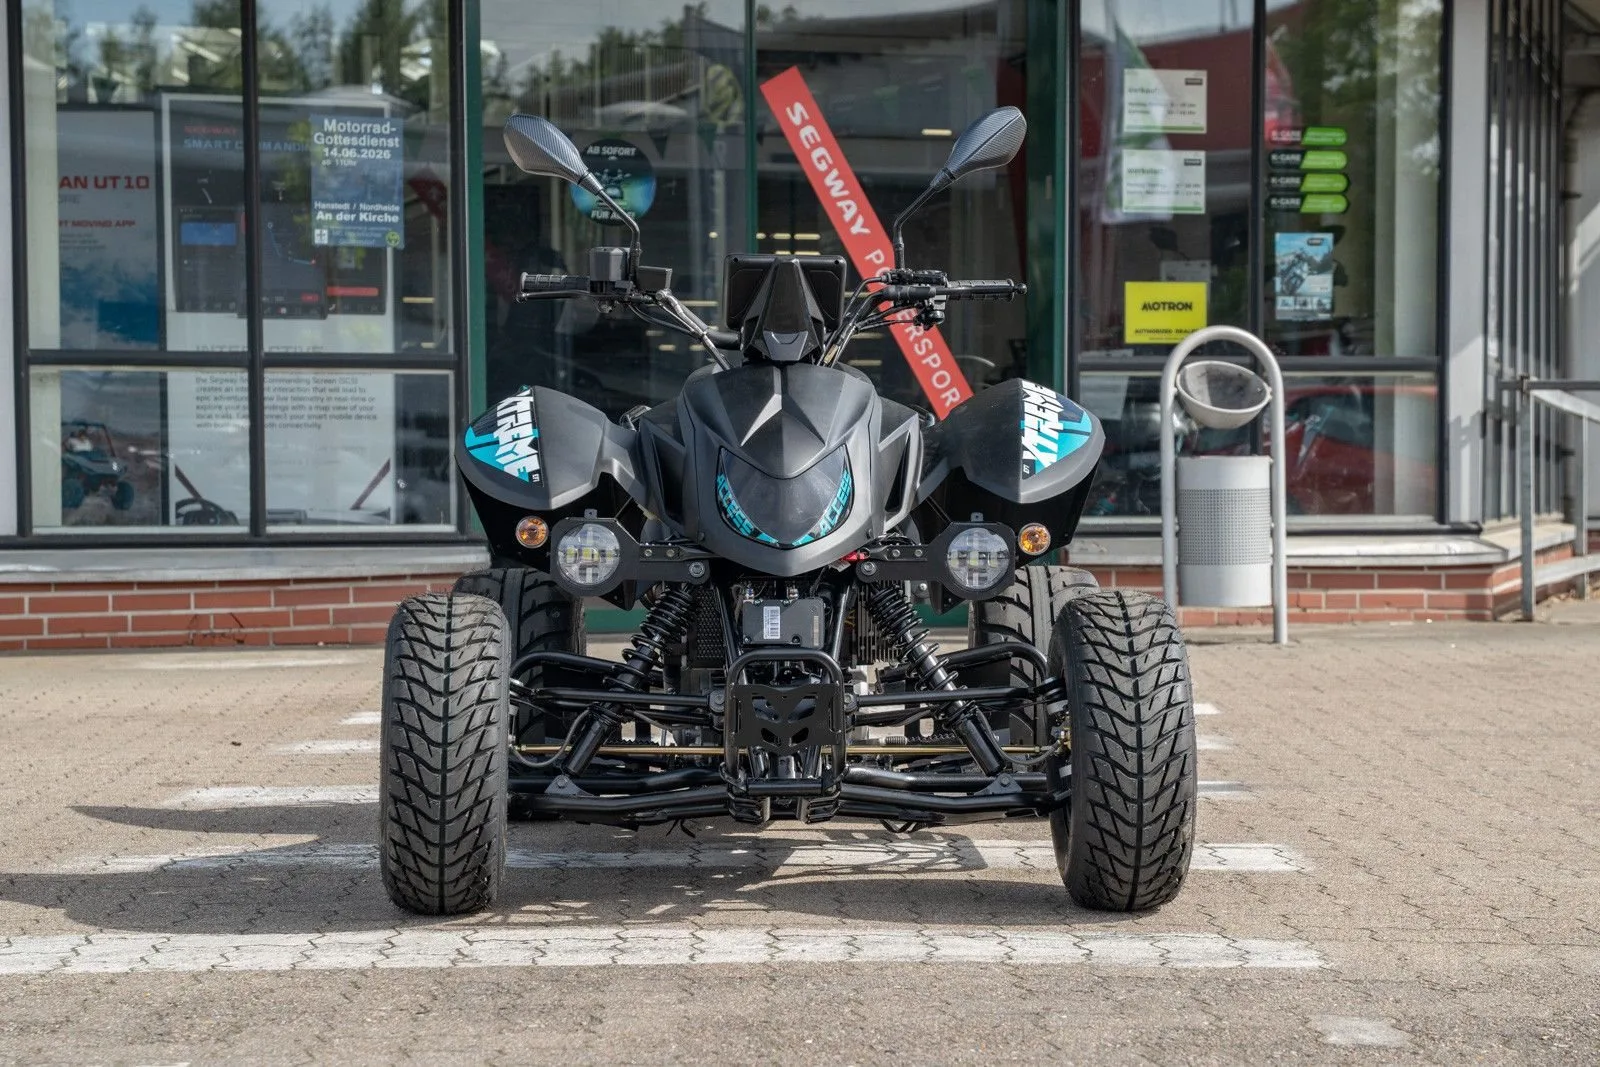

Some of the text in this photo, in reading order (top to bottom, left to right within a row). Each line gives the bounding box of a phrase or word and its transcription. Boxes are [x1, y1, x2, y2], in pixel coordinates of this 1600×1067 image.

[323, 118, 397, 134] Motorrad-
[184, 139, 231, 149] SMART
[313, 132, 400, 148] Gottesdienst
[322, 147, 391, 160] 14.06.2026
[587, 145, 636, 157] AB SOFORT
[786, 101, 872, 237] SEGWAY
[316, 211, 400, 224] An der Kirche
[591, 209, 610, 220] FÜR
[1021, 380, 1065, 468] XTREME
[494, 388, 541, 480] XTREME
[716, 473, 756, 537] ACCESS
[819, 468, 852, 537] ACCESS
